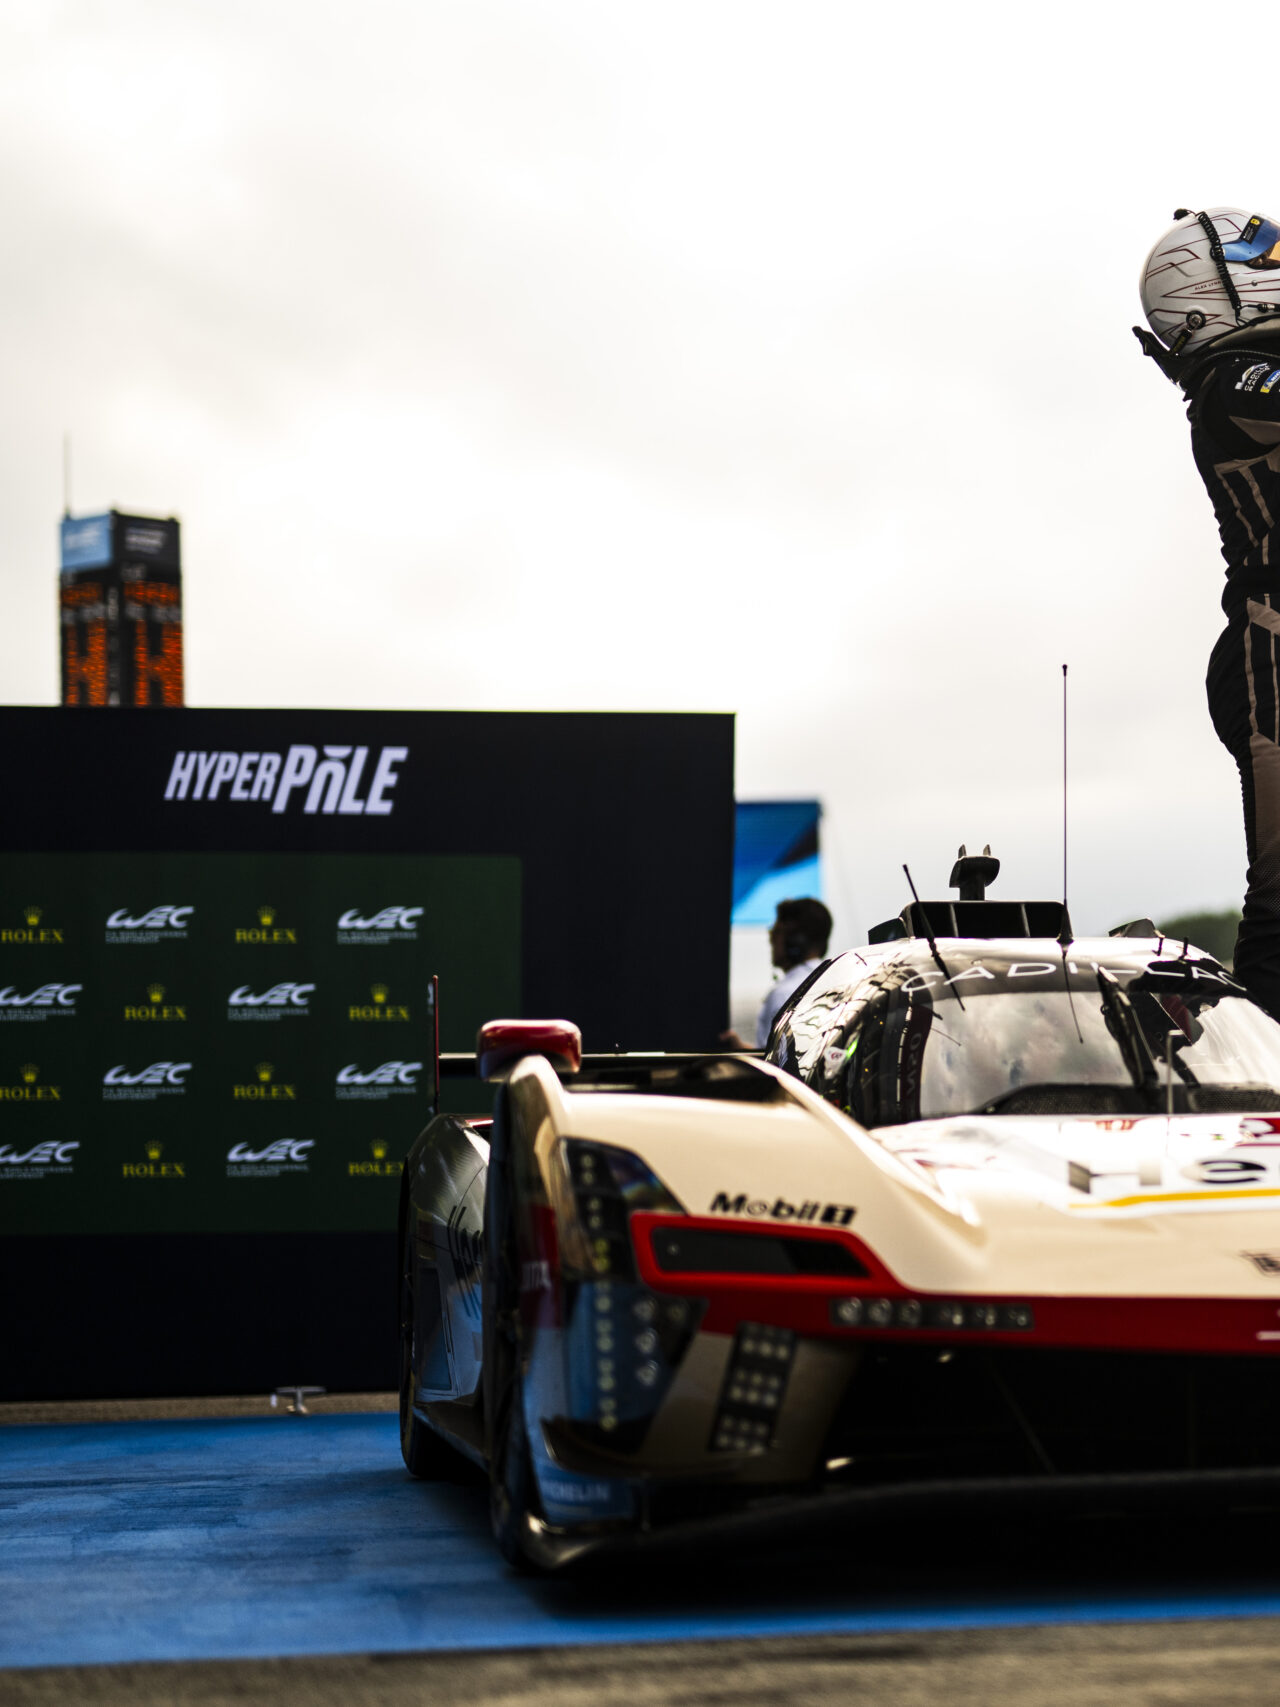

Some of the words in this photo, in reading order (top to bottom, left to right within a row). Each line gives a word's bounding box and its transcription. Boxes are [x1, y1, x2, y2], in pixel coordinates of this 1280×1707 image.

[106, 905, 194, 928] WEC
[337, 906, 424, 929] WEC
[1, 929, 64, 943] ROLEX
[235, 929, 297, 943] ROLEX
[228, 982, 316, 1006] WEC
[124, 1006, 186, 1021] ROLEX
[349, 1006, 409, 1021] ROLEX
[103, 1062, 192, 1085] WEC
[336, 1061, 423, 1084] WEC
[0, 1086, 60, 1100] ROLEX
[234, 1085, 296, 1099] ROLEX
[227, 1138, 315, 1162] WEC
[122, 1163, 185, 1178] ROLEX
[710, 1192, 820, 1221] Mobil
